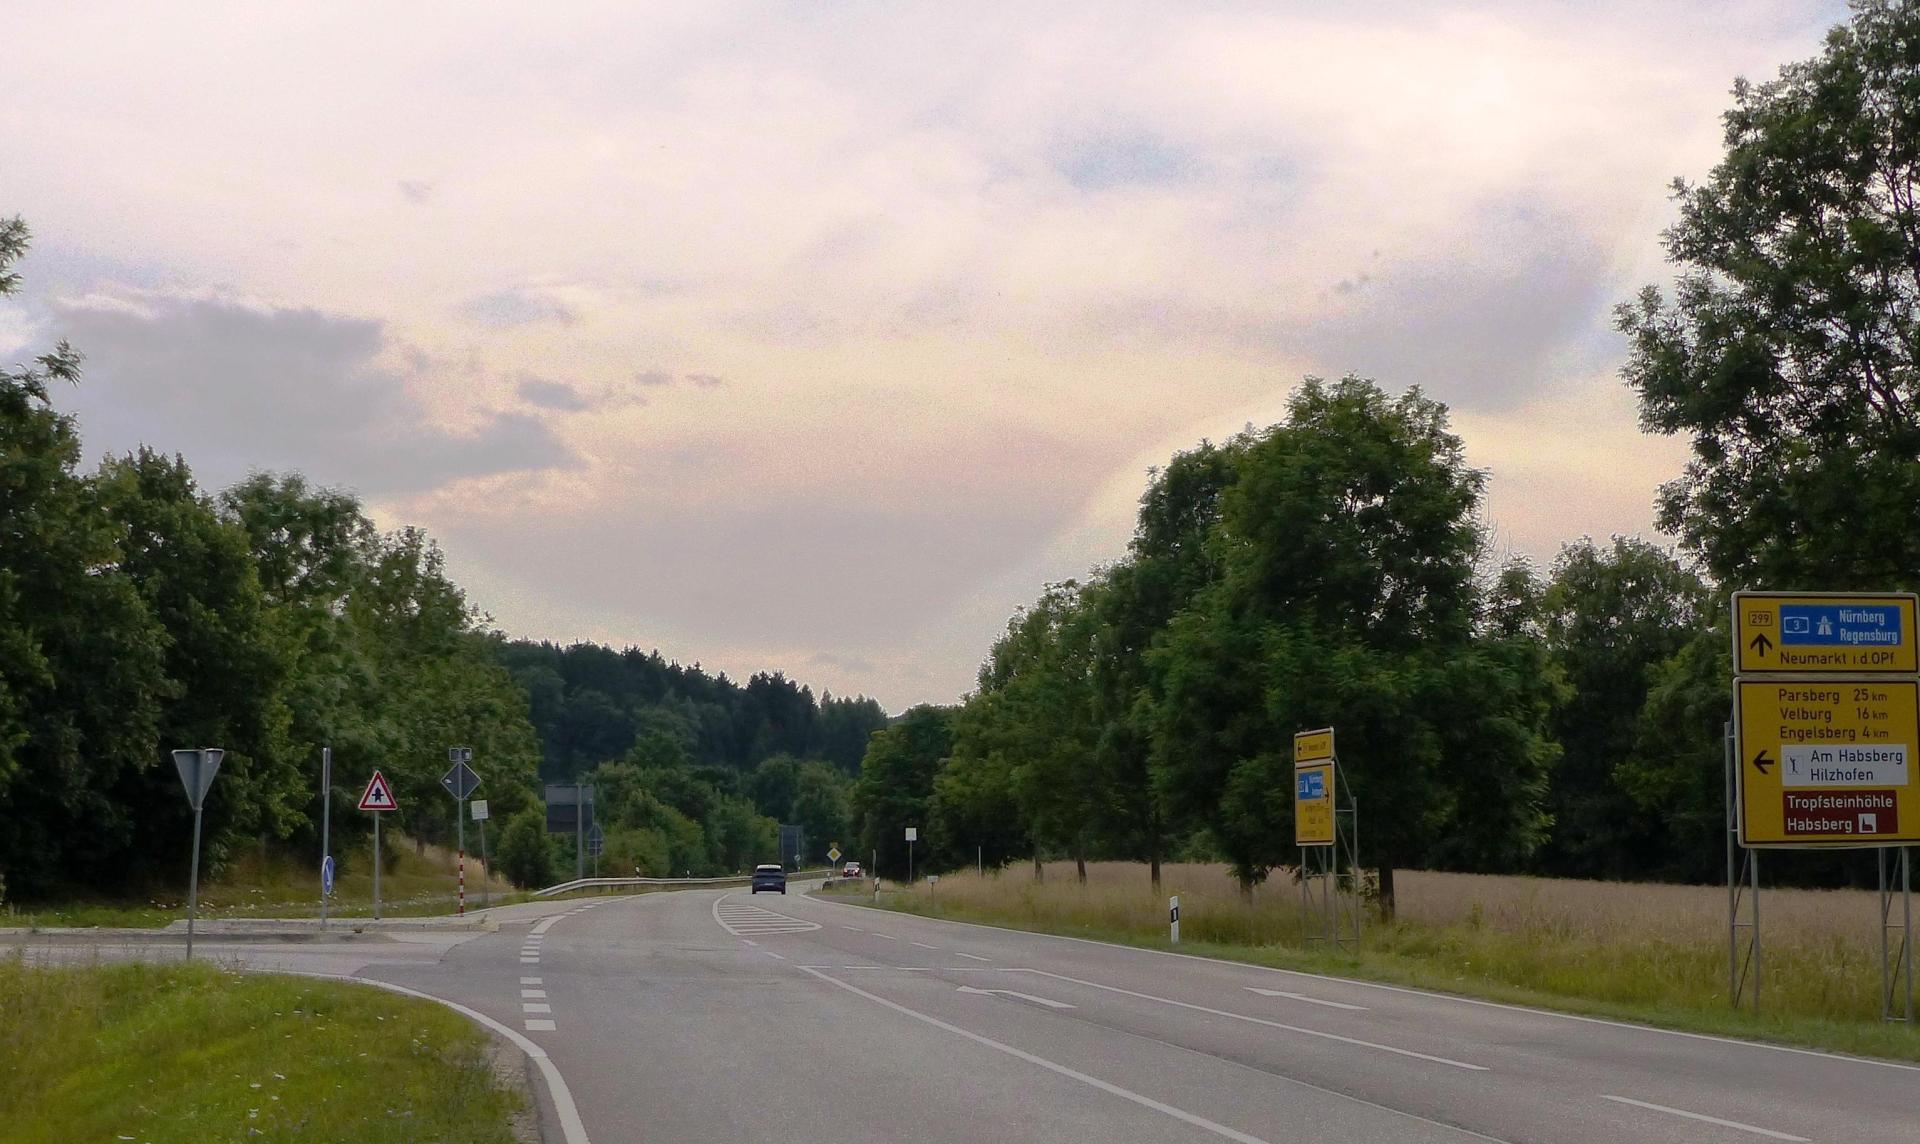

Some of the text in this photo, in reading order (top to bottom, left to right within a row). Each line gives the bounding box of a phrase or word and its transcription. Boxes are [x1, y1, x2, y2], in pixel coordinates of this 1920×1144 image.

[1752, 614, 1769, 624] 299
[1839, 610, 1885, 626] Nürnberg
[1793, 621, 1799, 630] 3
[1840, 629, 1897, 644] Regensburg
[1780, 652, 1846, 665] Neumarkt
[1779, 689, 1888, 704] Parsberg 25 km
[1780, 708, 1888, 722] Velburg 16 km
[1780, 727, 1888, 741] Engelsberg 4 km
[1811, 750, 1903, 764] Am Habsberg
[1811, 769, 1873, 781] Hilzhofen
[1788, 795, 1893, 810] Tropfsteinhöhle
[1787, 818, 1852, 833] Habsberg
